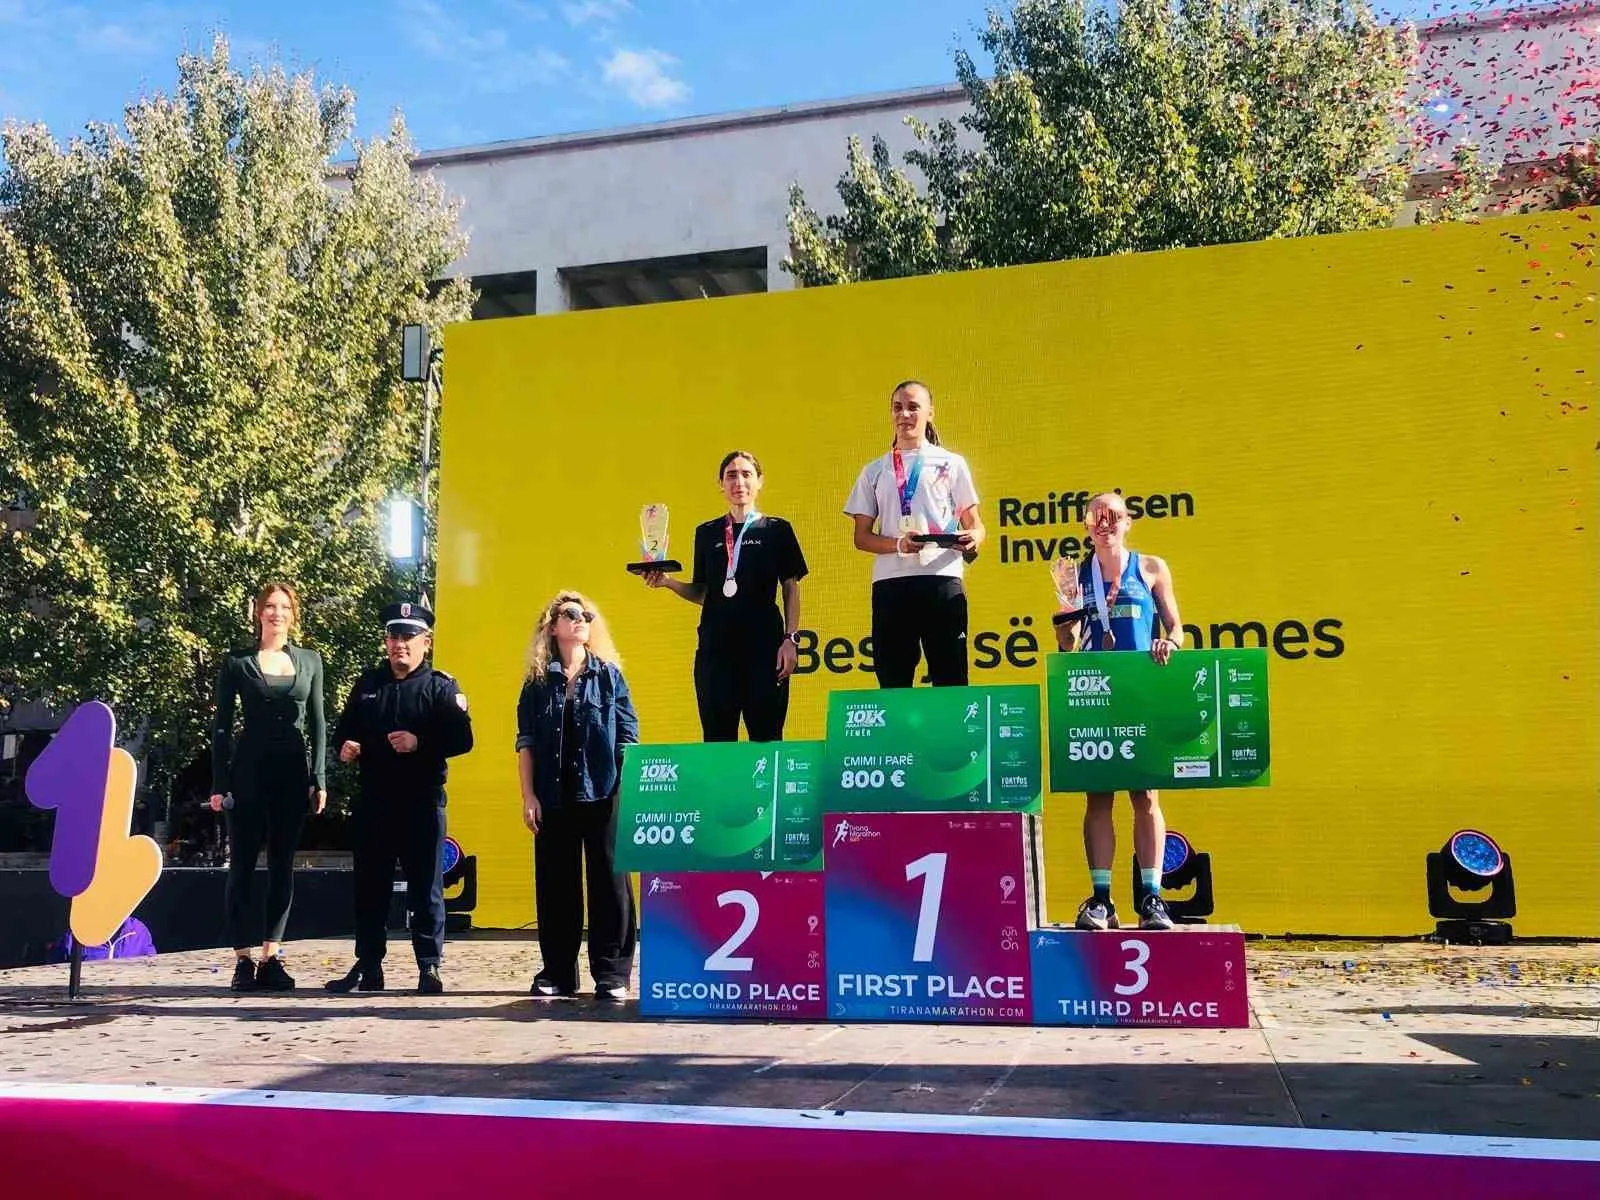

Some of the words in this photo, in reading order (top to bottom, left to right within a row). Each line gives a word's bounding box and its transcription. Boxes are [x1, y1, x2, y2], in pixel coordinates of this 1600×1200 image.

[1000, 488, 1194, 527] Raiffsen
[1001, 534, 1095, 563] Inves
[974, 616, 1040, 668] së
[1113, 723, 1147, 737] TRETË
[1068, 740, 1114, 761] 500
[1119, 739, 1136, 760] €
[841, 769, 885, 788] 800
[890, 769, 906, 788] €
[633, 825, 676, 845] 600
[680, 825, 695, 845] €
[905, 852, 948, 962] 1
[704, 889, 760, 971] 2
[1113, 939, 1151, 996] 3
[651, 982, 741, 1000] SECOND
[749, 983, 820, 1001] PLACE
[838, 974, 919, 997] FIRST
[927, 975, 1025, 999] PLACE
[1058, 1000, 1131, 1016] THIRD
[1142, 1001, 1219, 1018] PLACE
